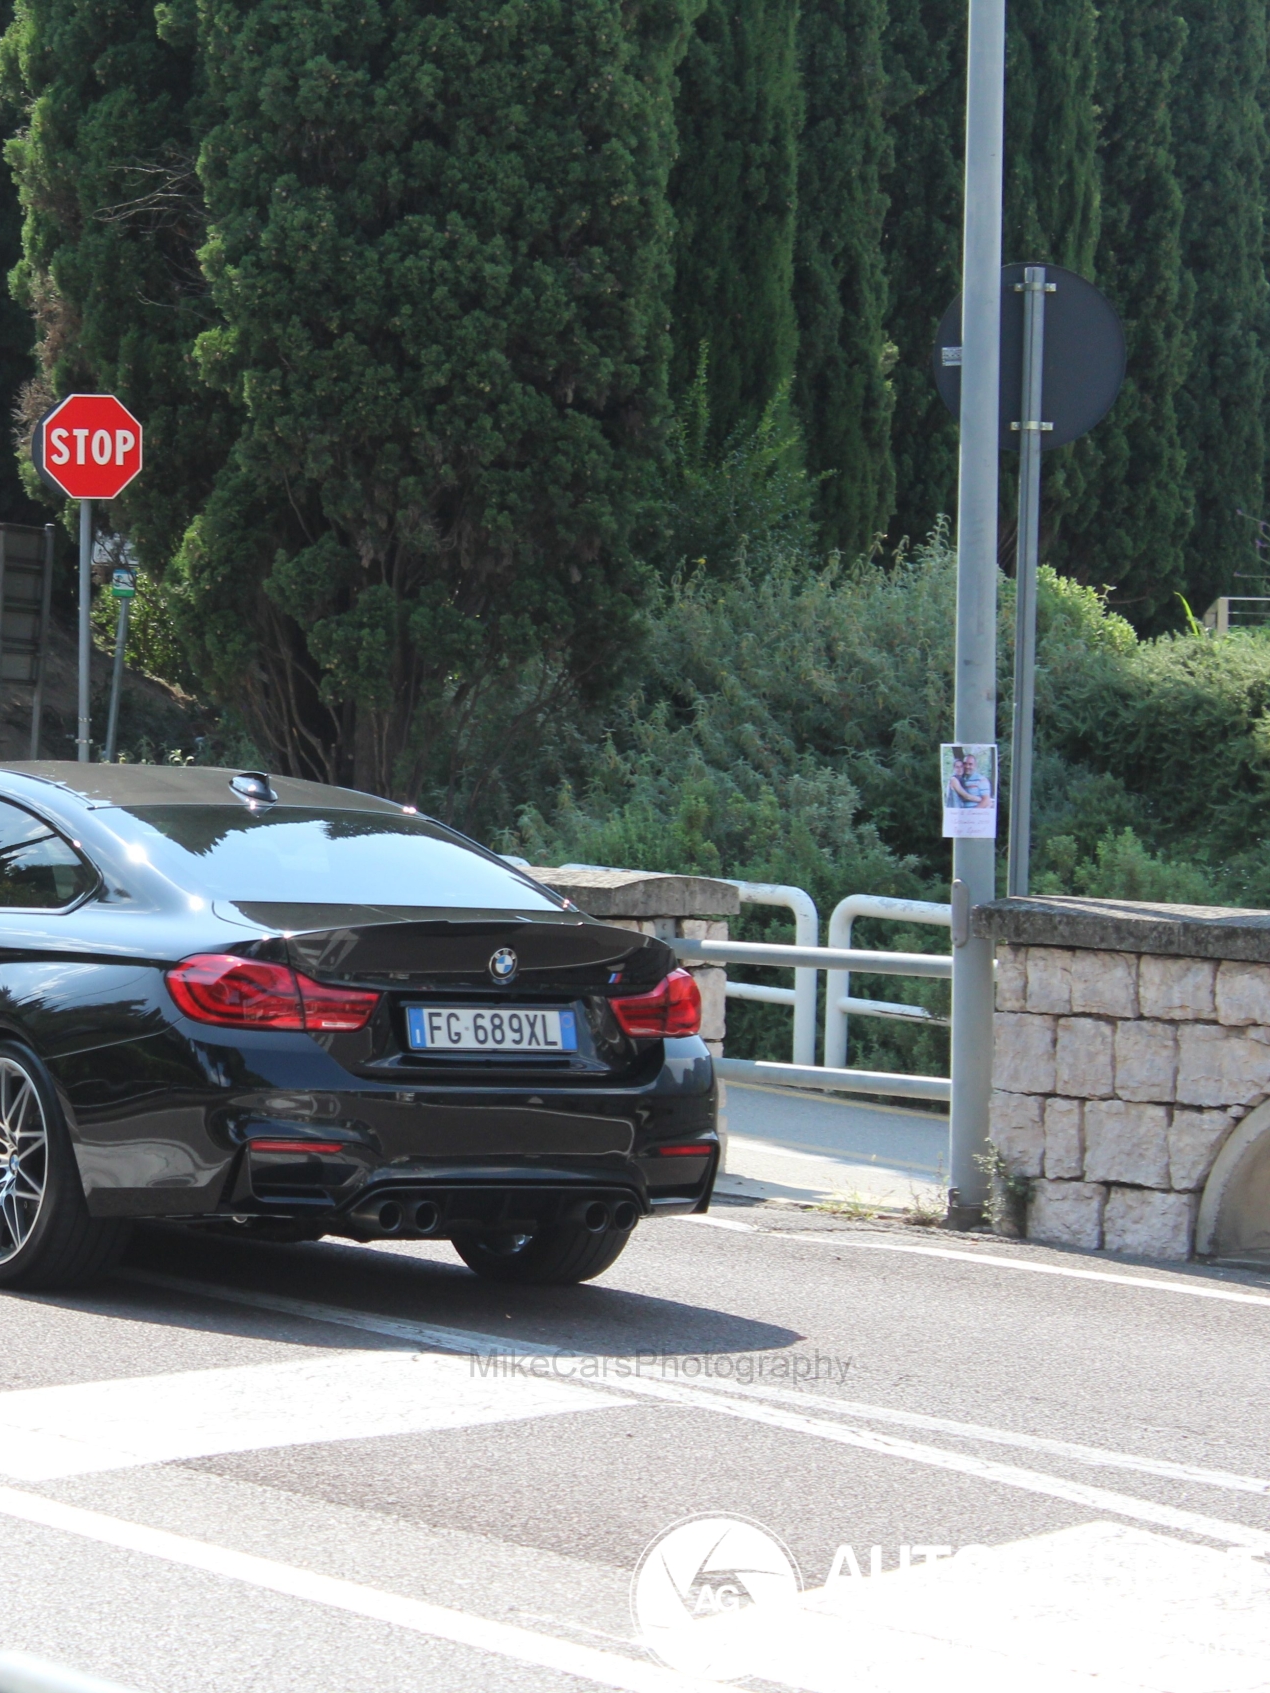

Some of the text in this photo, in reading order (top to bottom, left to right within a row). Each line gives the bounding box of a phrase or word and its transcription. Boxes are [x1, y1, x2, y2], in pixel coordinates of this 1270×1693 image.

[50, 427, 136, 466] STOP
[428, 1012, 462, 1045] FG
[472, 1012, 558, 1046] 689XL
